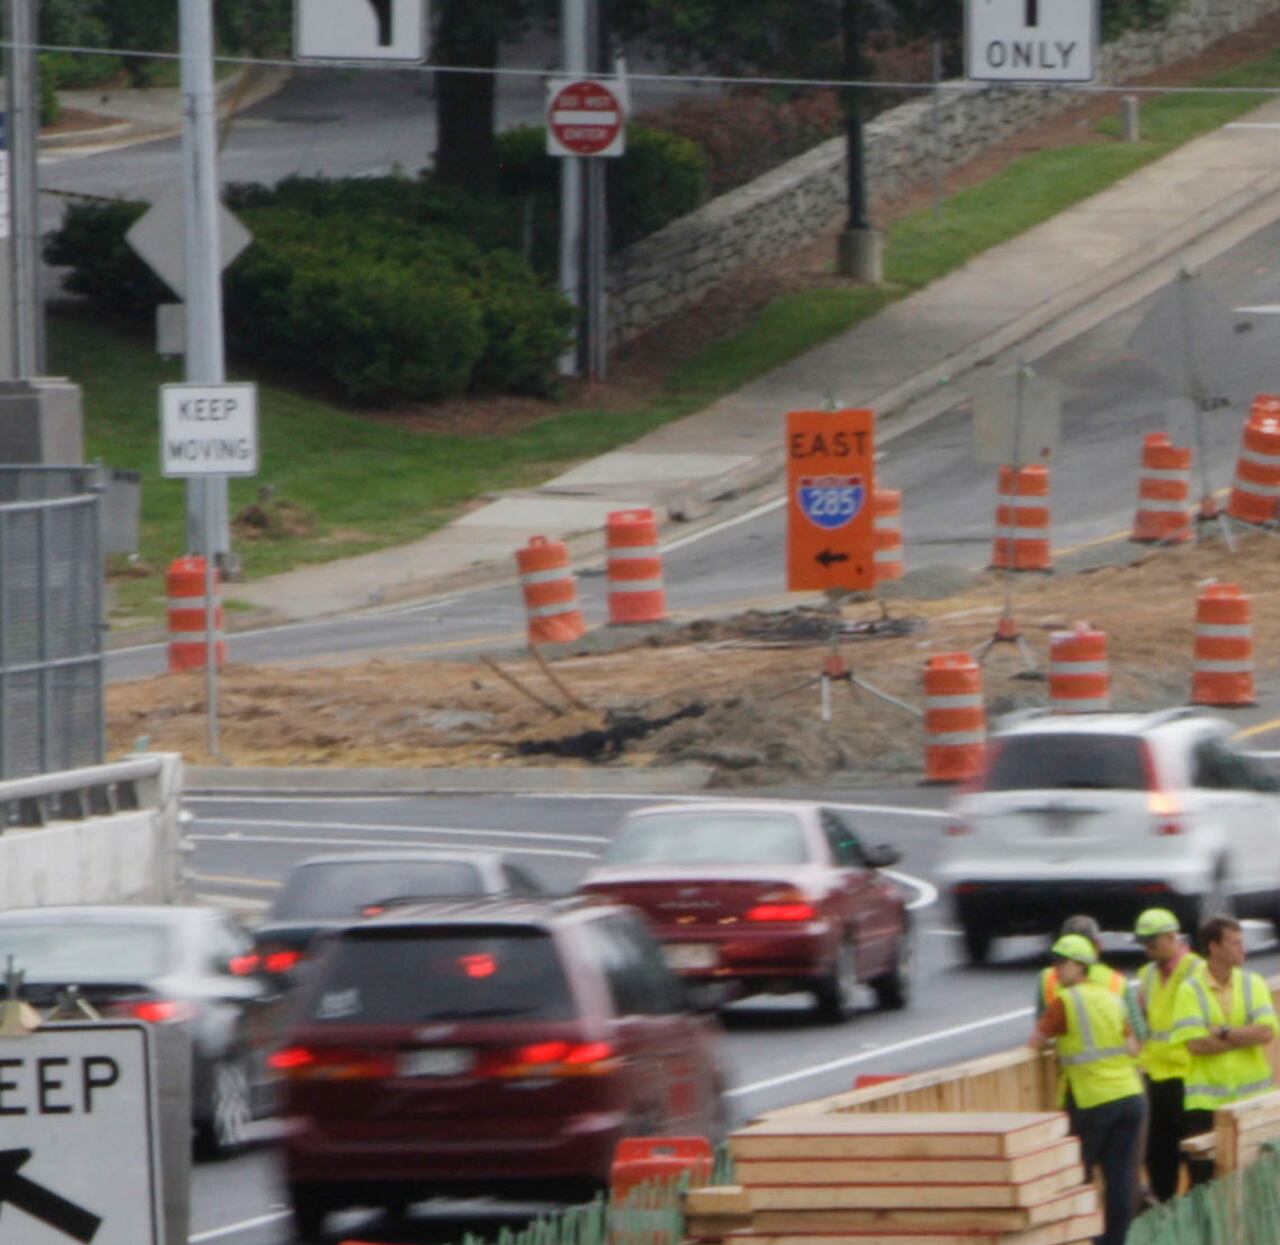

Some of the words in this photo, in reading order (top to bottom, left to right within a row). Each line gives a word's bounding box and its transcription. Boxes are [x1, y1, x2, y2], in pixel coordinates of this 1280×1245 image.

[985, 40, 1077, 69] ONLY
[179, 399, 238, 421] KEEP
[167, 439, 251, 461] MOVING
[791, 431, 867, 458] EAST
[809, 489, 856, 516] 285
[0, 1055, 121, 1115] EEP
